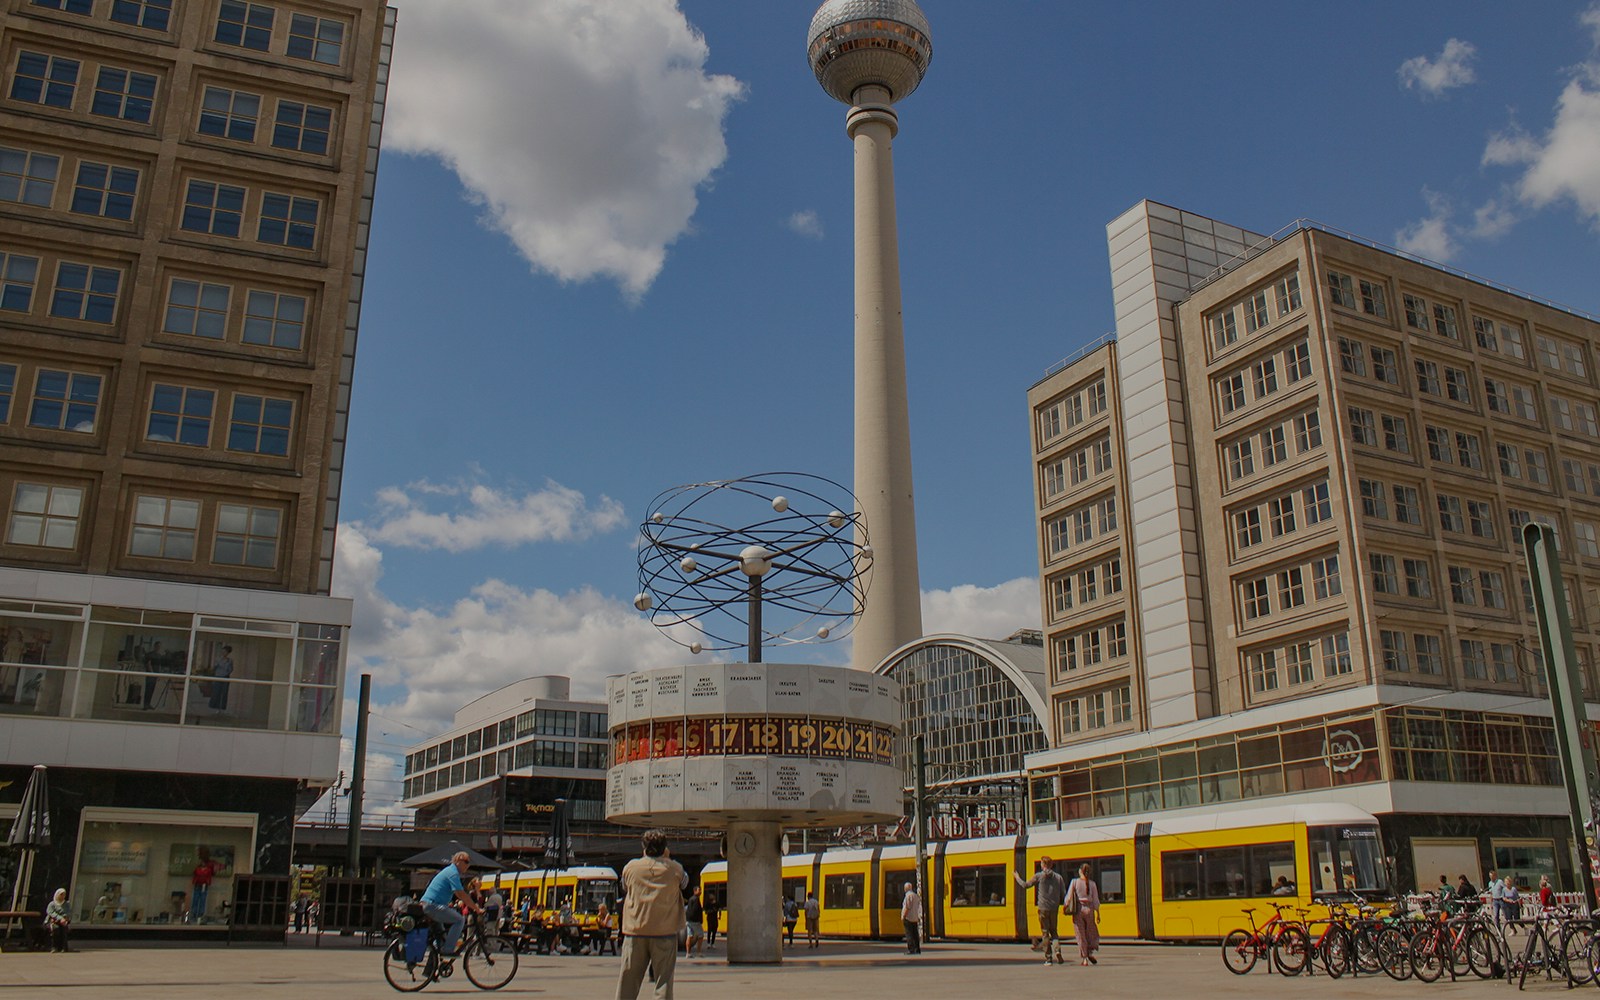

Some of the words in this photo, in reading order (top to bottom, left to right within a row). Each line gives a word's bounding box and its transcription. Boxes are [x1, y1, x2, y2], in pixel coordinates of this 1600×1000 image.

[674, 724, 700, 749] 16
[709, 723, 739, 748] 17
[749, 723, 779, 748] 18
[788, 725, 817, 749] 19
[822, 726, 851, 751] 20
[855, 730, 873, 753] 21
[876, 733, 892, 757] 22
[1331, 740, 1358, 760] C&A
[526, 803, 556, 814] TKmax
